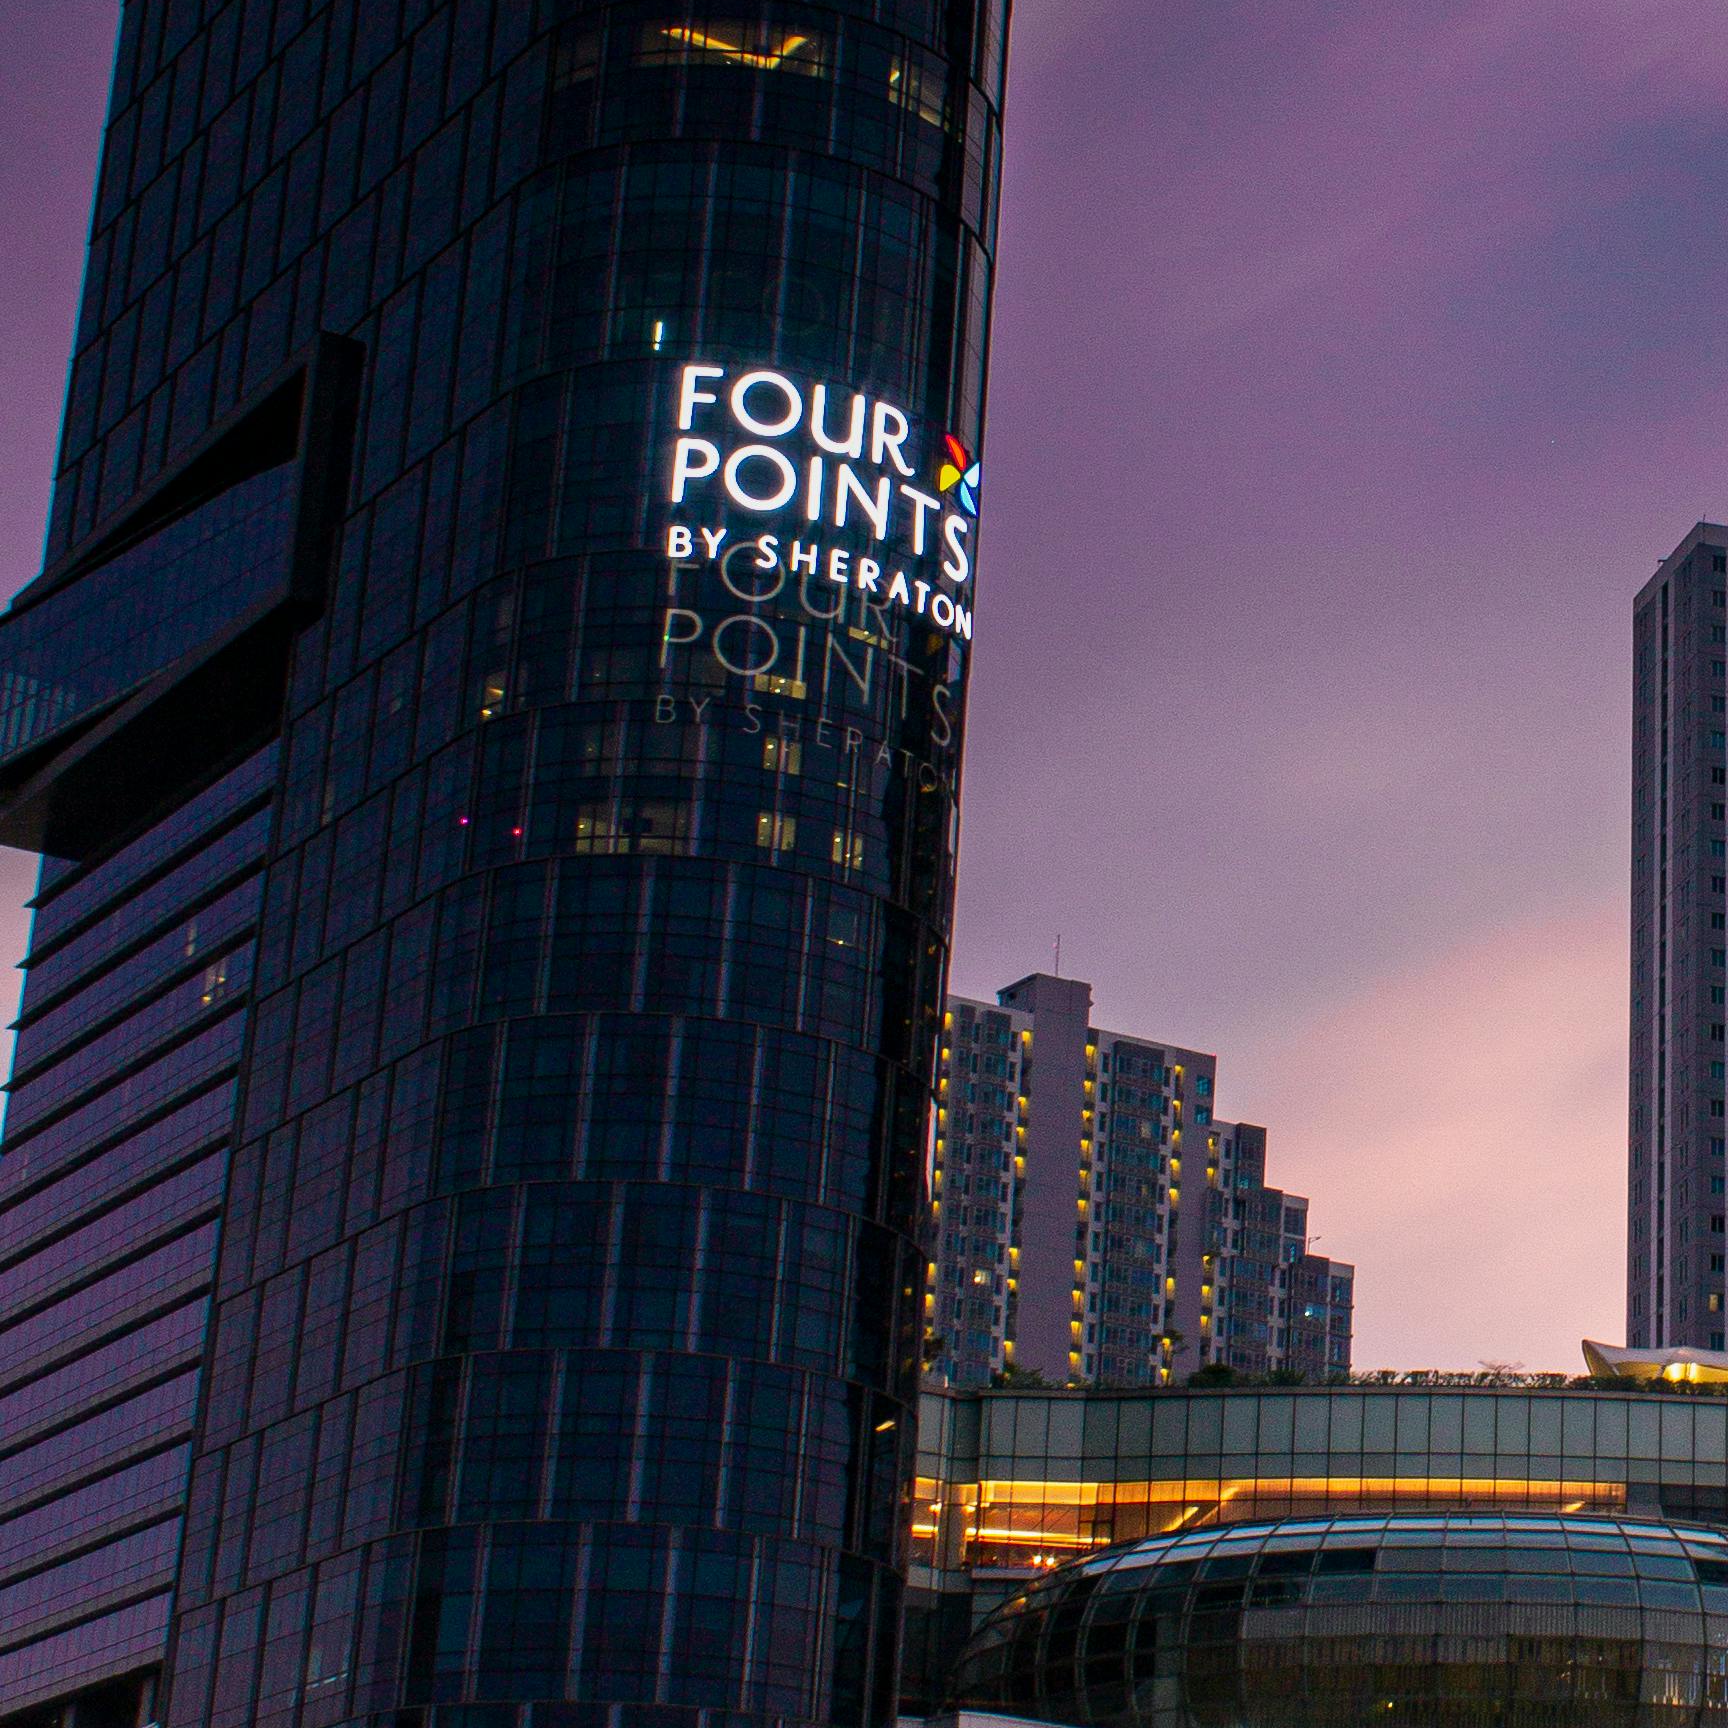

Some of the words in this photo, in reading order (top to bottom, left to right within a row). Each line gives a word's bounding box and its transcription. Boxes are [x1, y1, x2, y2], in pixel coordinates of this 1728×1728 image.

[678, 363, 916, 478] FOUR
[669, 435, 970, 585] POINTS
[667, 525, 727, 560] BY
[754, 533, 974, 641] SHERATON
